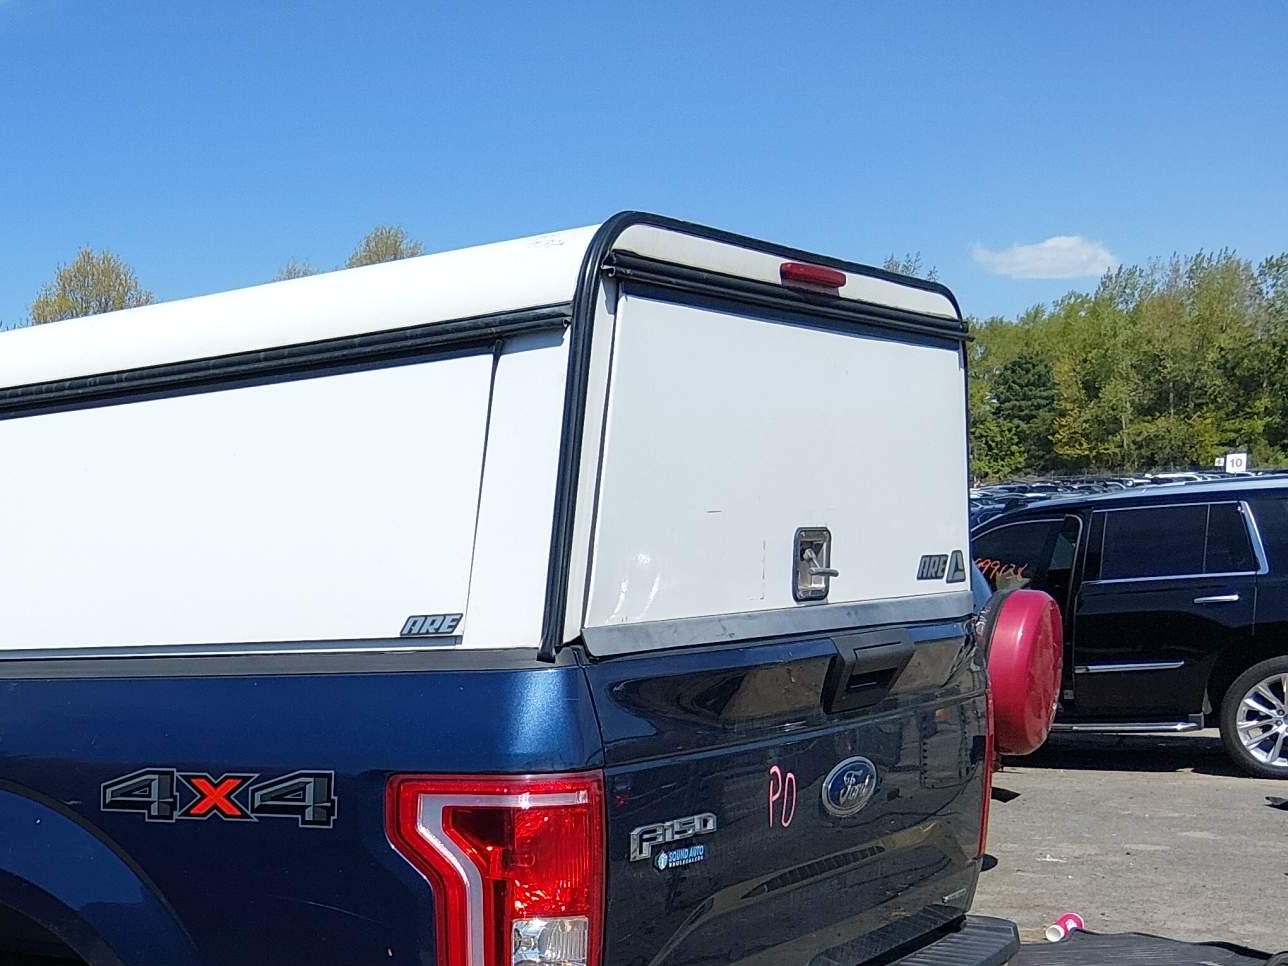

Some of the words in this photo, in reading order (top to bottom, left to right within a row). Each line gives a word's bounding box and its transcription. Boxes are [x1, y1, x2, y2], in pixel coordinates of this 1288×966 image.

[1229, 458, 1243, 468] 10
[402, 615, 462, 634] ARE
[769, 765, 797, 828] PD
[669, 848, 689, 862] SOUND
[689, 845, 704, 858] AUTO
